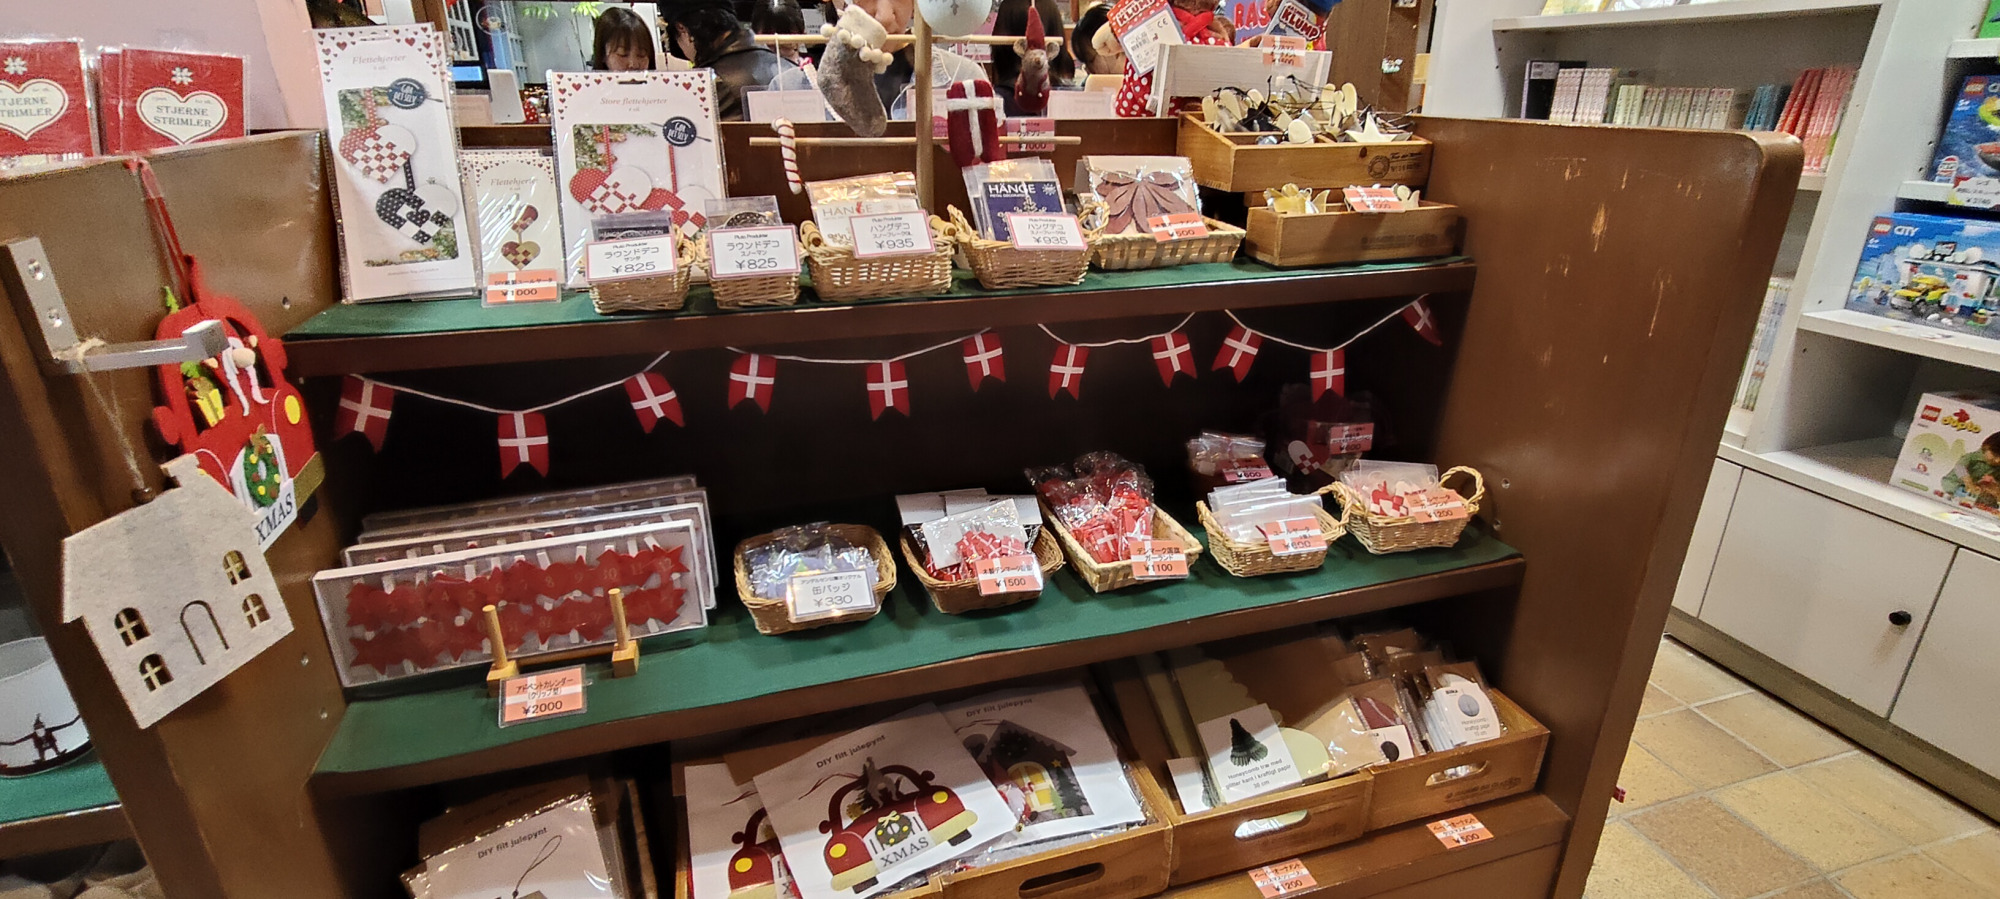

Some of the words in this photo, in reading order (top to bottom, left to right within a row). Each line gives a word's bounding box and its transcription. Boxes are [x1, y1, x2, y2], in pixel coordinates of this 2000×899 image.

[1281, 8, 1320, 38] KLUMP
[0, 96, 48, 106] TJERNE
[0, 108, 53, 118] TRIMLER
[156, 105, 208, 117] STJERNE
[153, 116, 212, 128] STRIMLER
[870, 222, 911, 232] ハングデコ
[1894, 225, 1919, 236] CITY
[726, 240, 780, 251] ラウンドデコ
[874, 238, 915, 249] ¥935
[1033, 236, 1069, 244] ¥935
[604, 247, 659, 259] ラウンドデコ
[611, 261, 656, 274] ¥825
[735, 257, 778, 270] ¥825
[254, 492, 293, 546] XMAS
[1425, 509, 1453, 518] ¥1200
[1144, 563, 1173, 572] ¥1100
[812, 582, 850, 595] 缶バッジ
[995, 577, 1026, 588] ¥1500
[813, 595, 853, 608] ¥330
[516, 677, 574, 694] アドベントカレンダー
[521, 701, 563, 715] ¥2000
[966, 708, 981, 717] DIY
[816, 756, 833, 769] DIY
[835, 748, 848, 761] filt
[850, 735, 886, 756] julepynt
[1228, 766, 1259, 779] Honeycomb
[478, 847, 493, 859] DIY
[496, 840, 509, 851] filt
[511, 827, 548, 847] julepynt
[881, 836, 929, 868] XMAS
